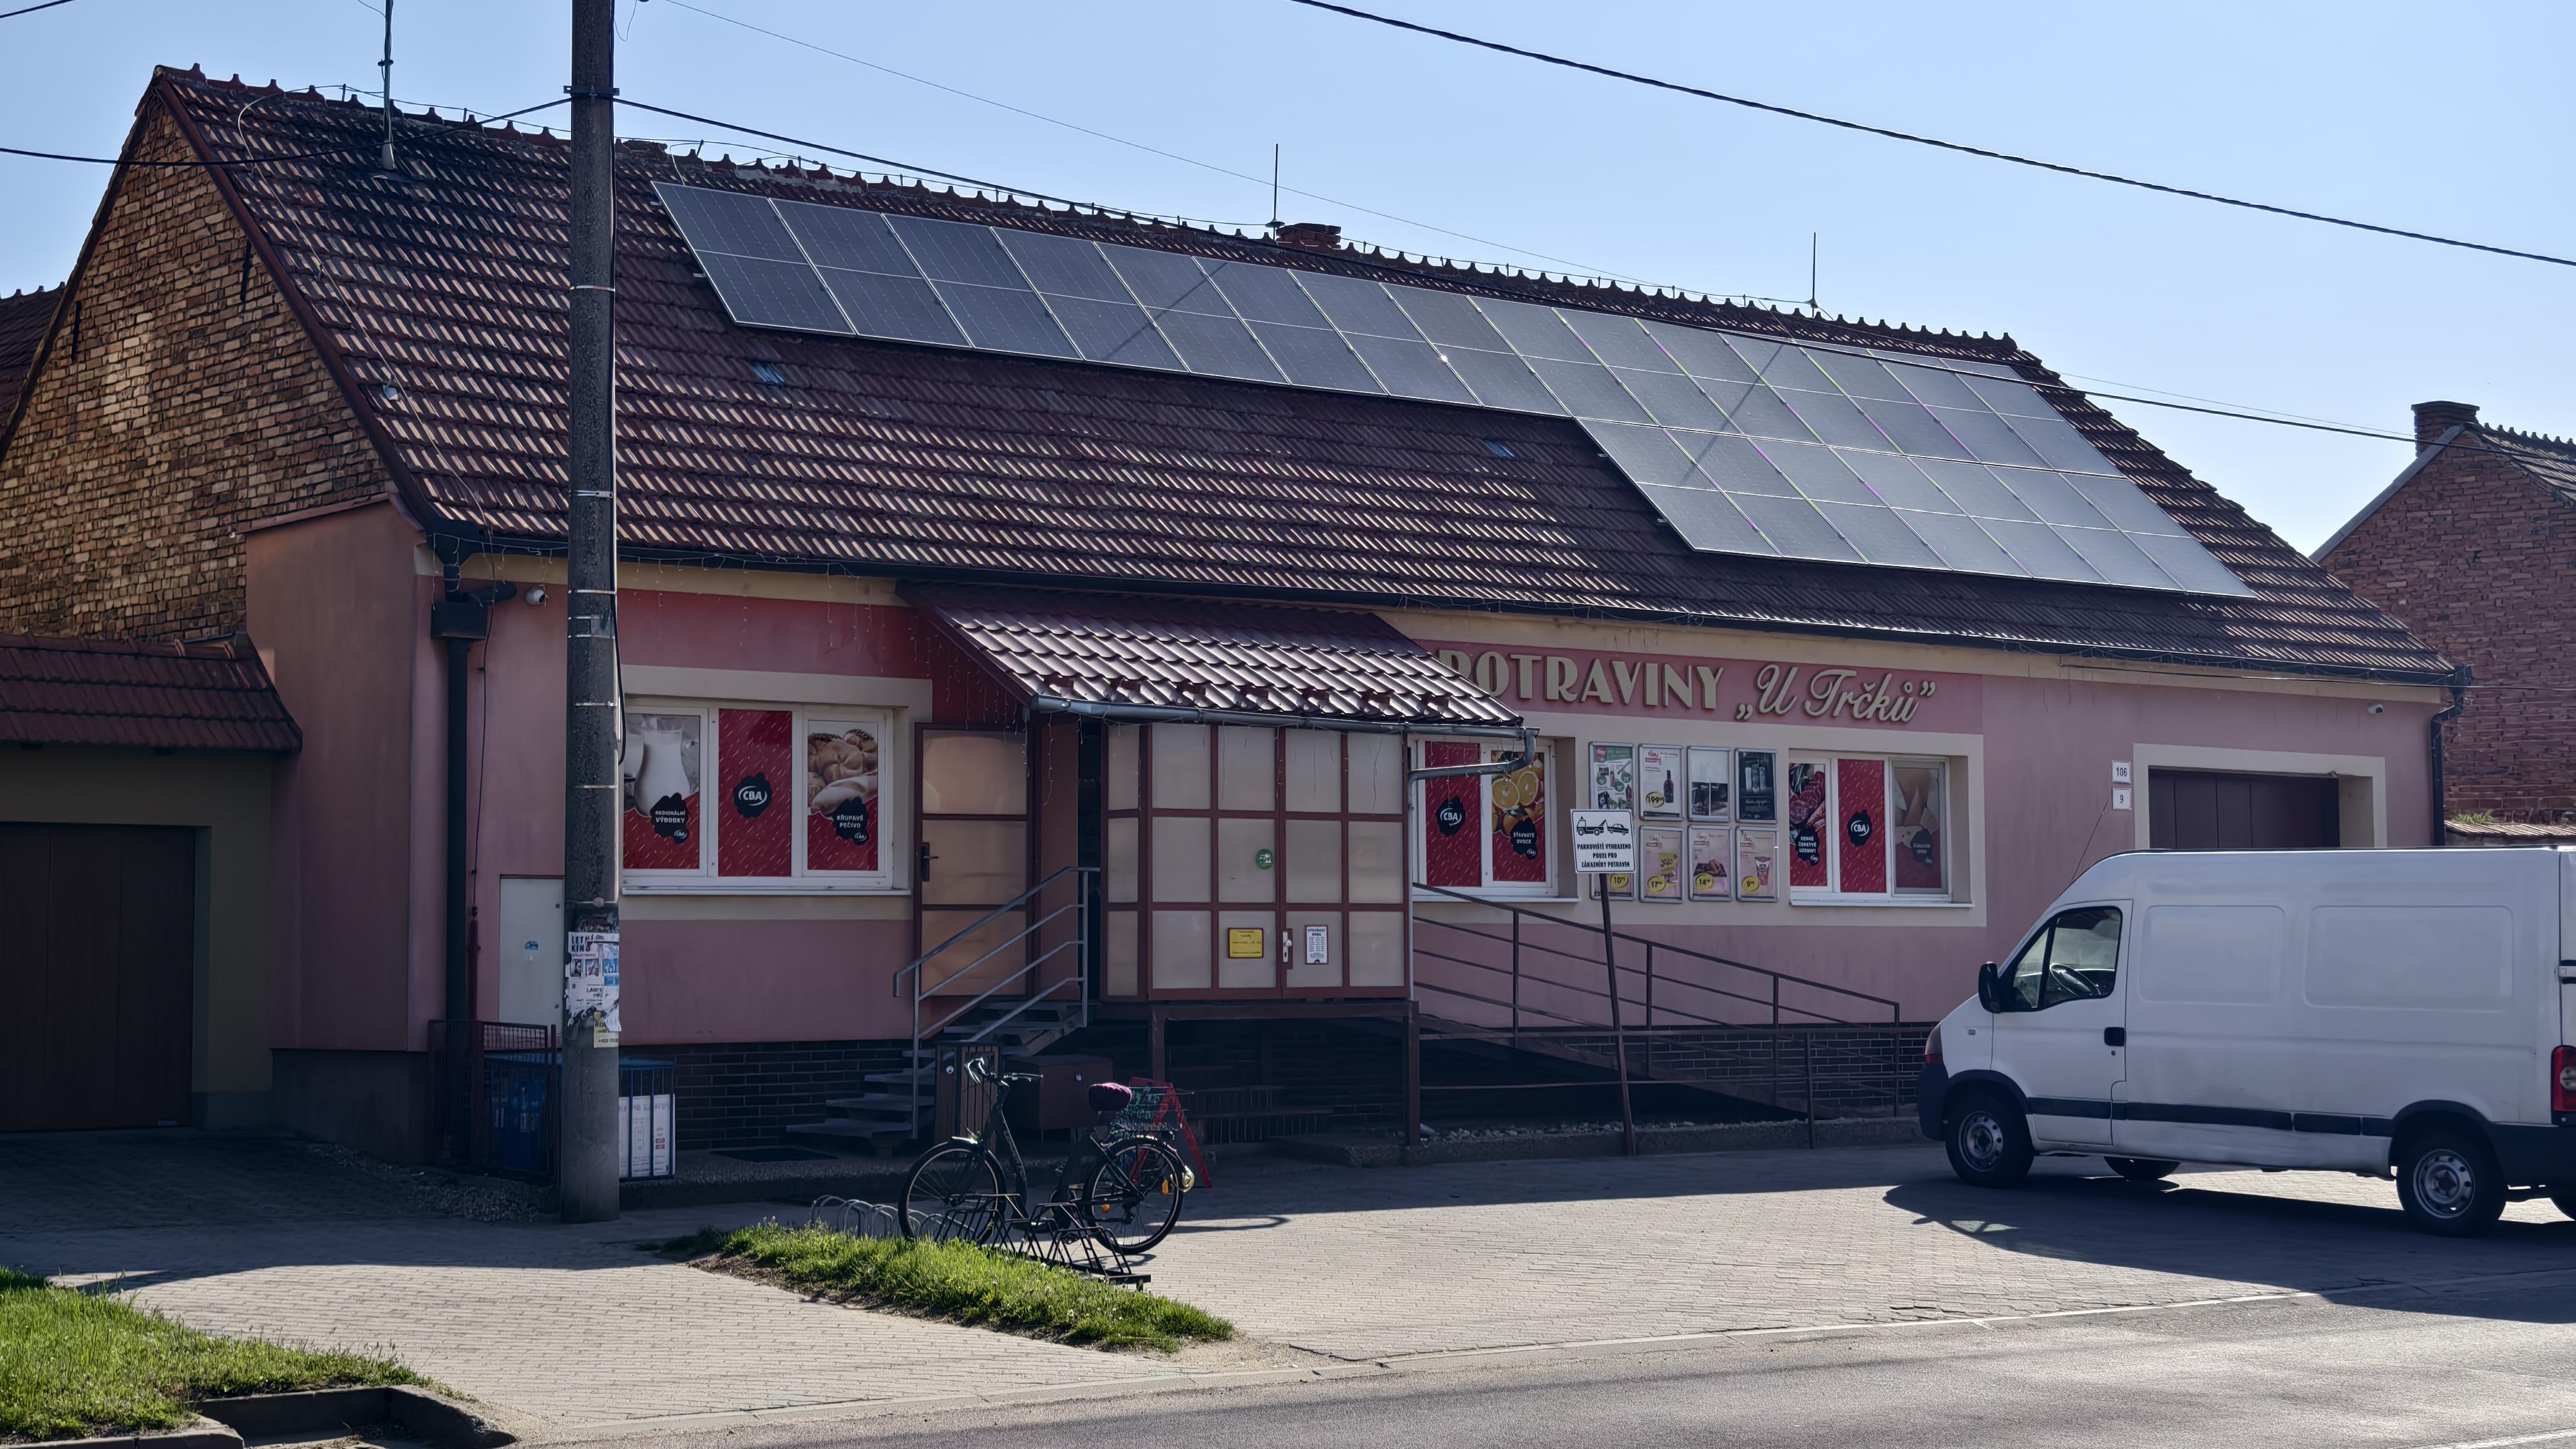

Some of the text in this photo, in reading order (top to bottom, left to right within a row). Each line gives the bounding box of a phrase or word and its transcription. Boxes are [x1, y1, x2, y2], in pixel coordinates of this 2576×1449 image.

[1438, 649, 1725, 709] POTRAVINY
[2116, 766, 2128, 777] 106
[743, 790, 762, 800] CBA
[2119, 794, 2124, 804] 9
[1443, 812, 1459, 821] CBA
[1853, 824, 1867, 833] CBA
[1577, 842, 1604, 850] PARKOVIŠTĚ
[1581, 860, 1606, 868] ZÁKAZNÍKY
